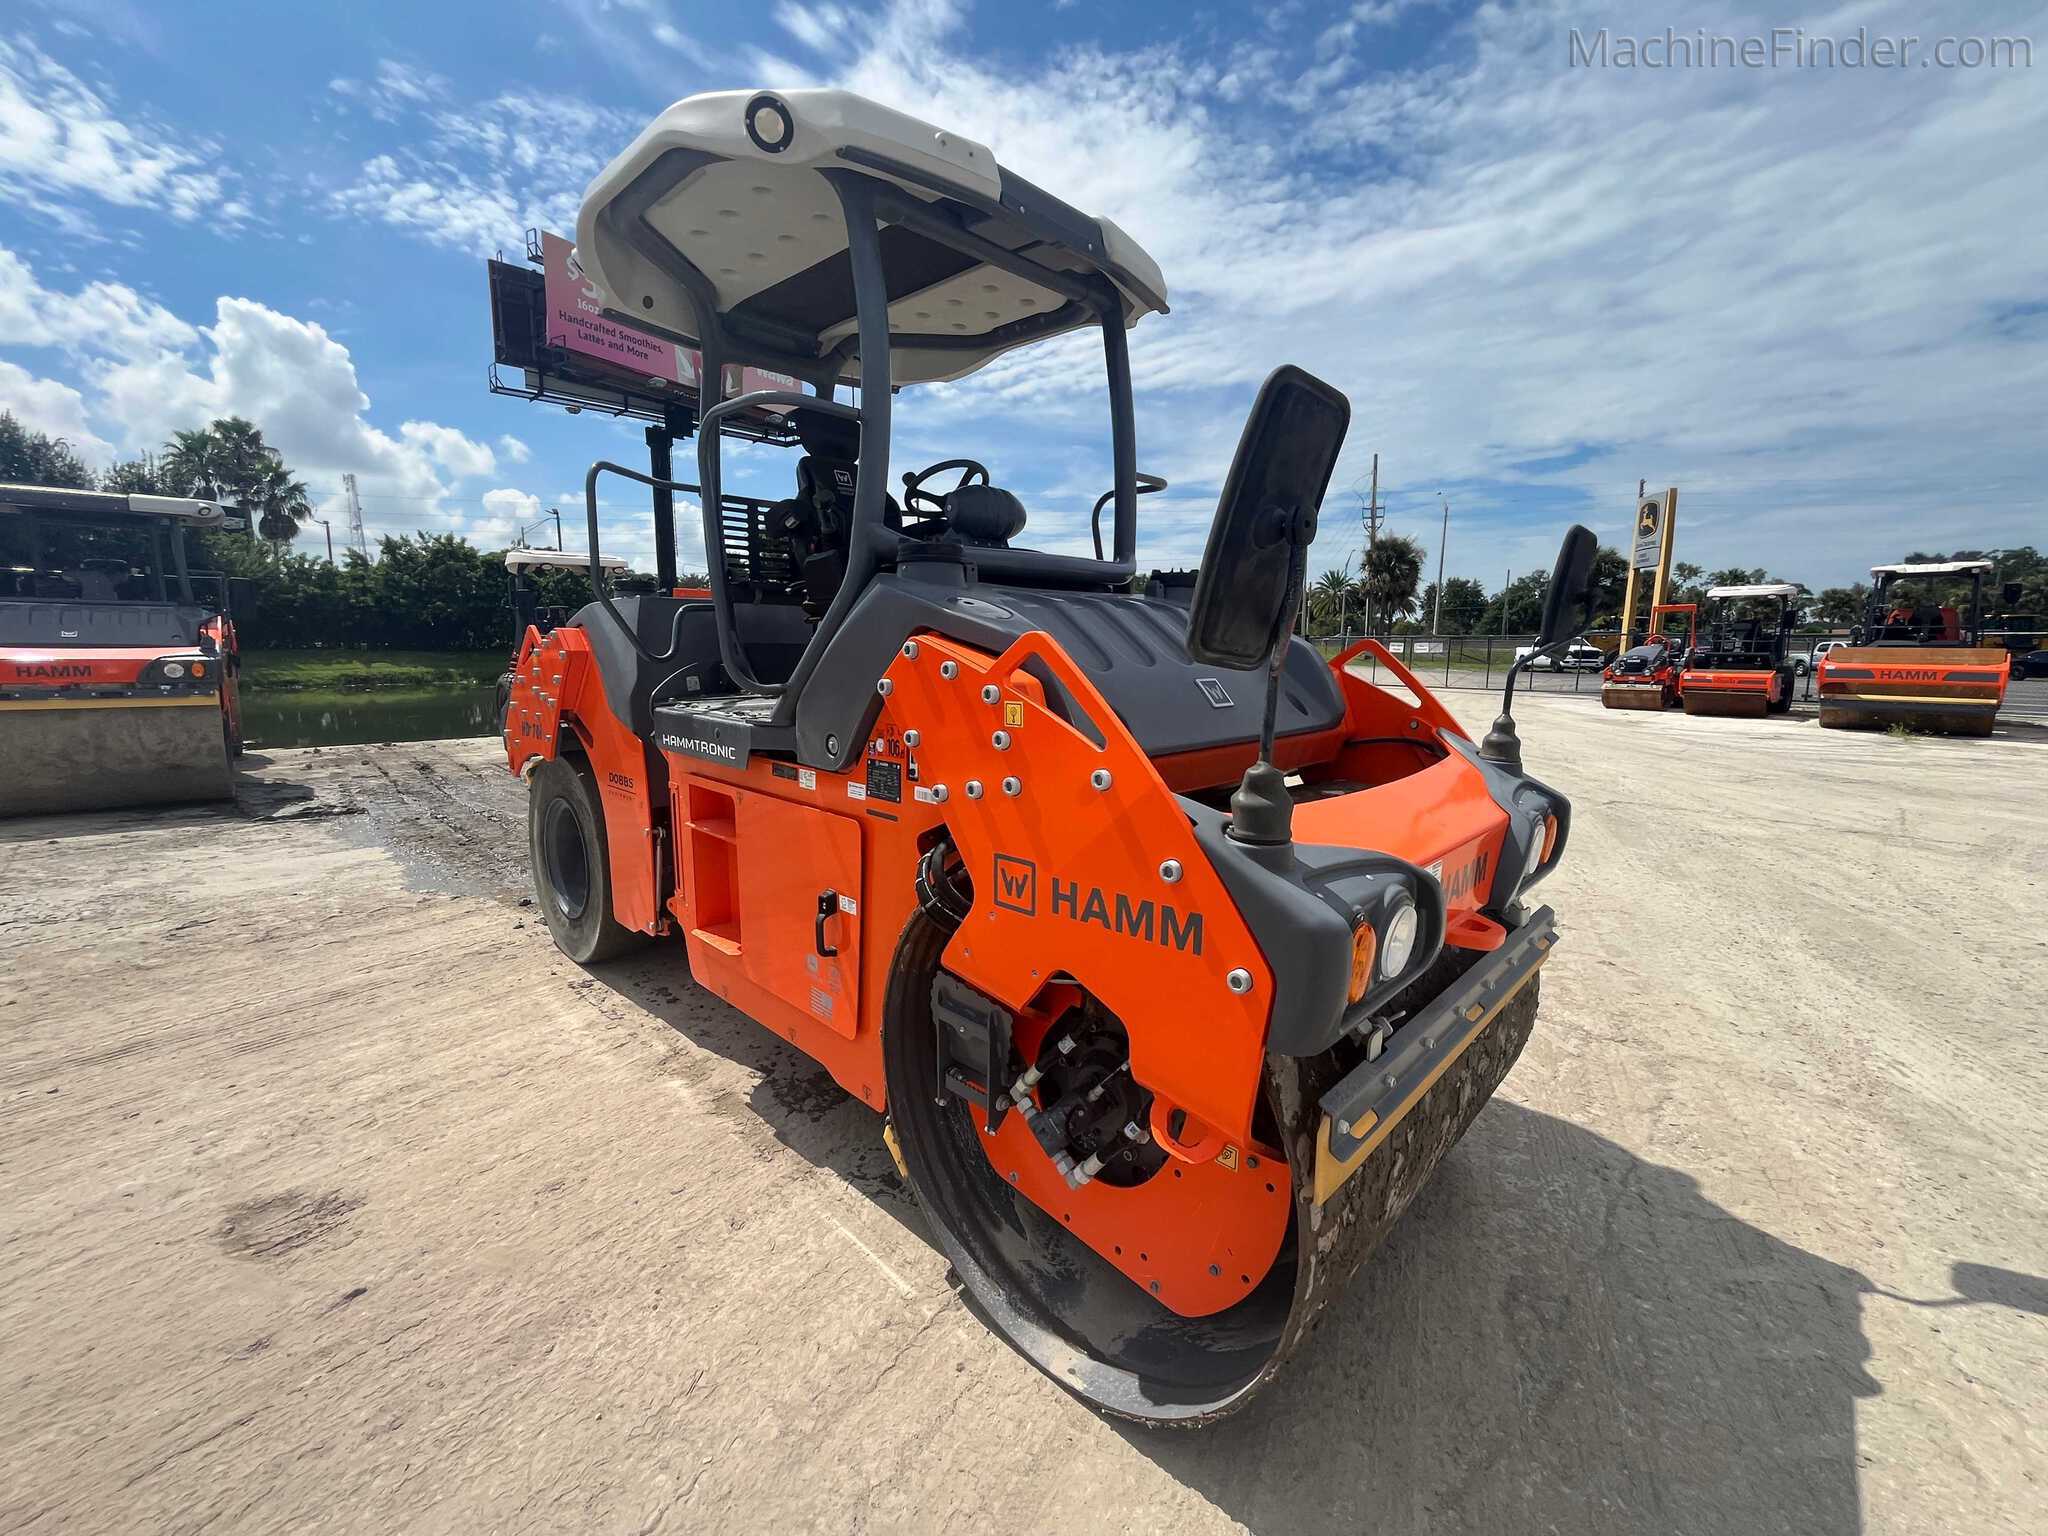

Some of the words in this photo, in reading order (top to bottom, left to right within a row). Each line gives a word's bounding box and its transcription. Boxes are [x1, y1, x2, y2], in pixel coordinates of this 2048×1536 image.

[559, 310, 616, 337] Handcrafted
[578, 329, 605, 346] Lattes
[608, 340, 624, 352] and
[627, 345, 649, 360] More
[15, 665, 92, 678] HAMM
[1879, 670, 1938, 681] HAMM
[662, 733, 737, 760] HAMMTRONIC
[608, 772, 634, 789] DOBBS
[1051, 877, 1204, 956] HAMM
